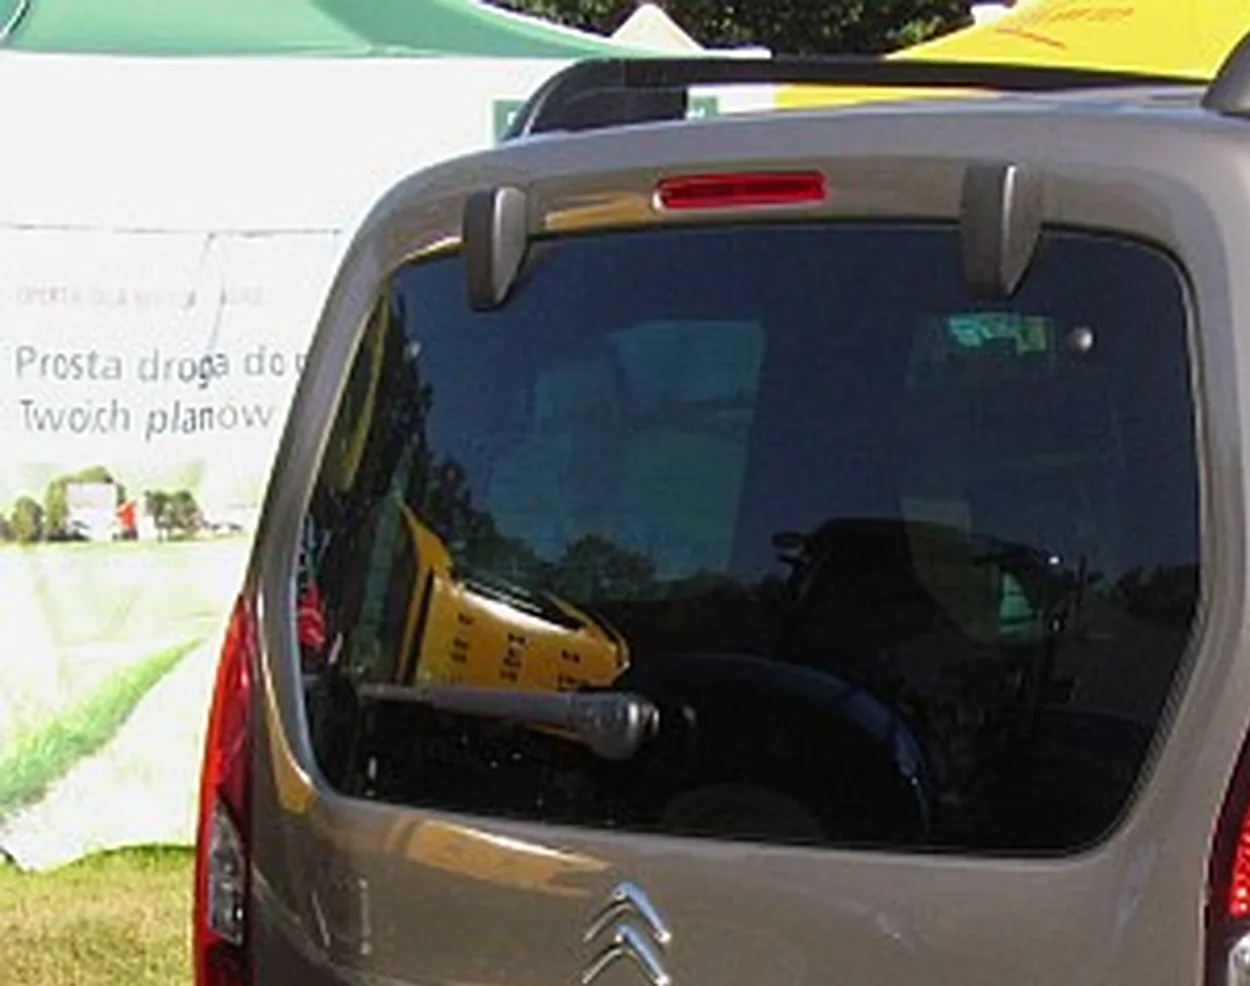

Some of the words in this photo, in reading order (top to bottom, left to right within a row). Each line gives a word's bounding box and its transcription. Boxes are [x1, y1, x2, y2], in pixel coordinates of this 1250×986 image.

[15, 346, 123, 381] Prosta
[138, 349, 230, 390] droga
[244, 347, 285, 377] do
[20, 399, 131, 434] Twoich
